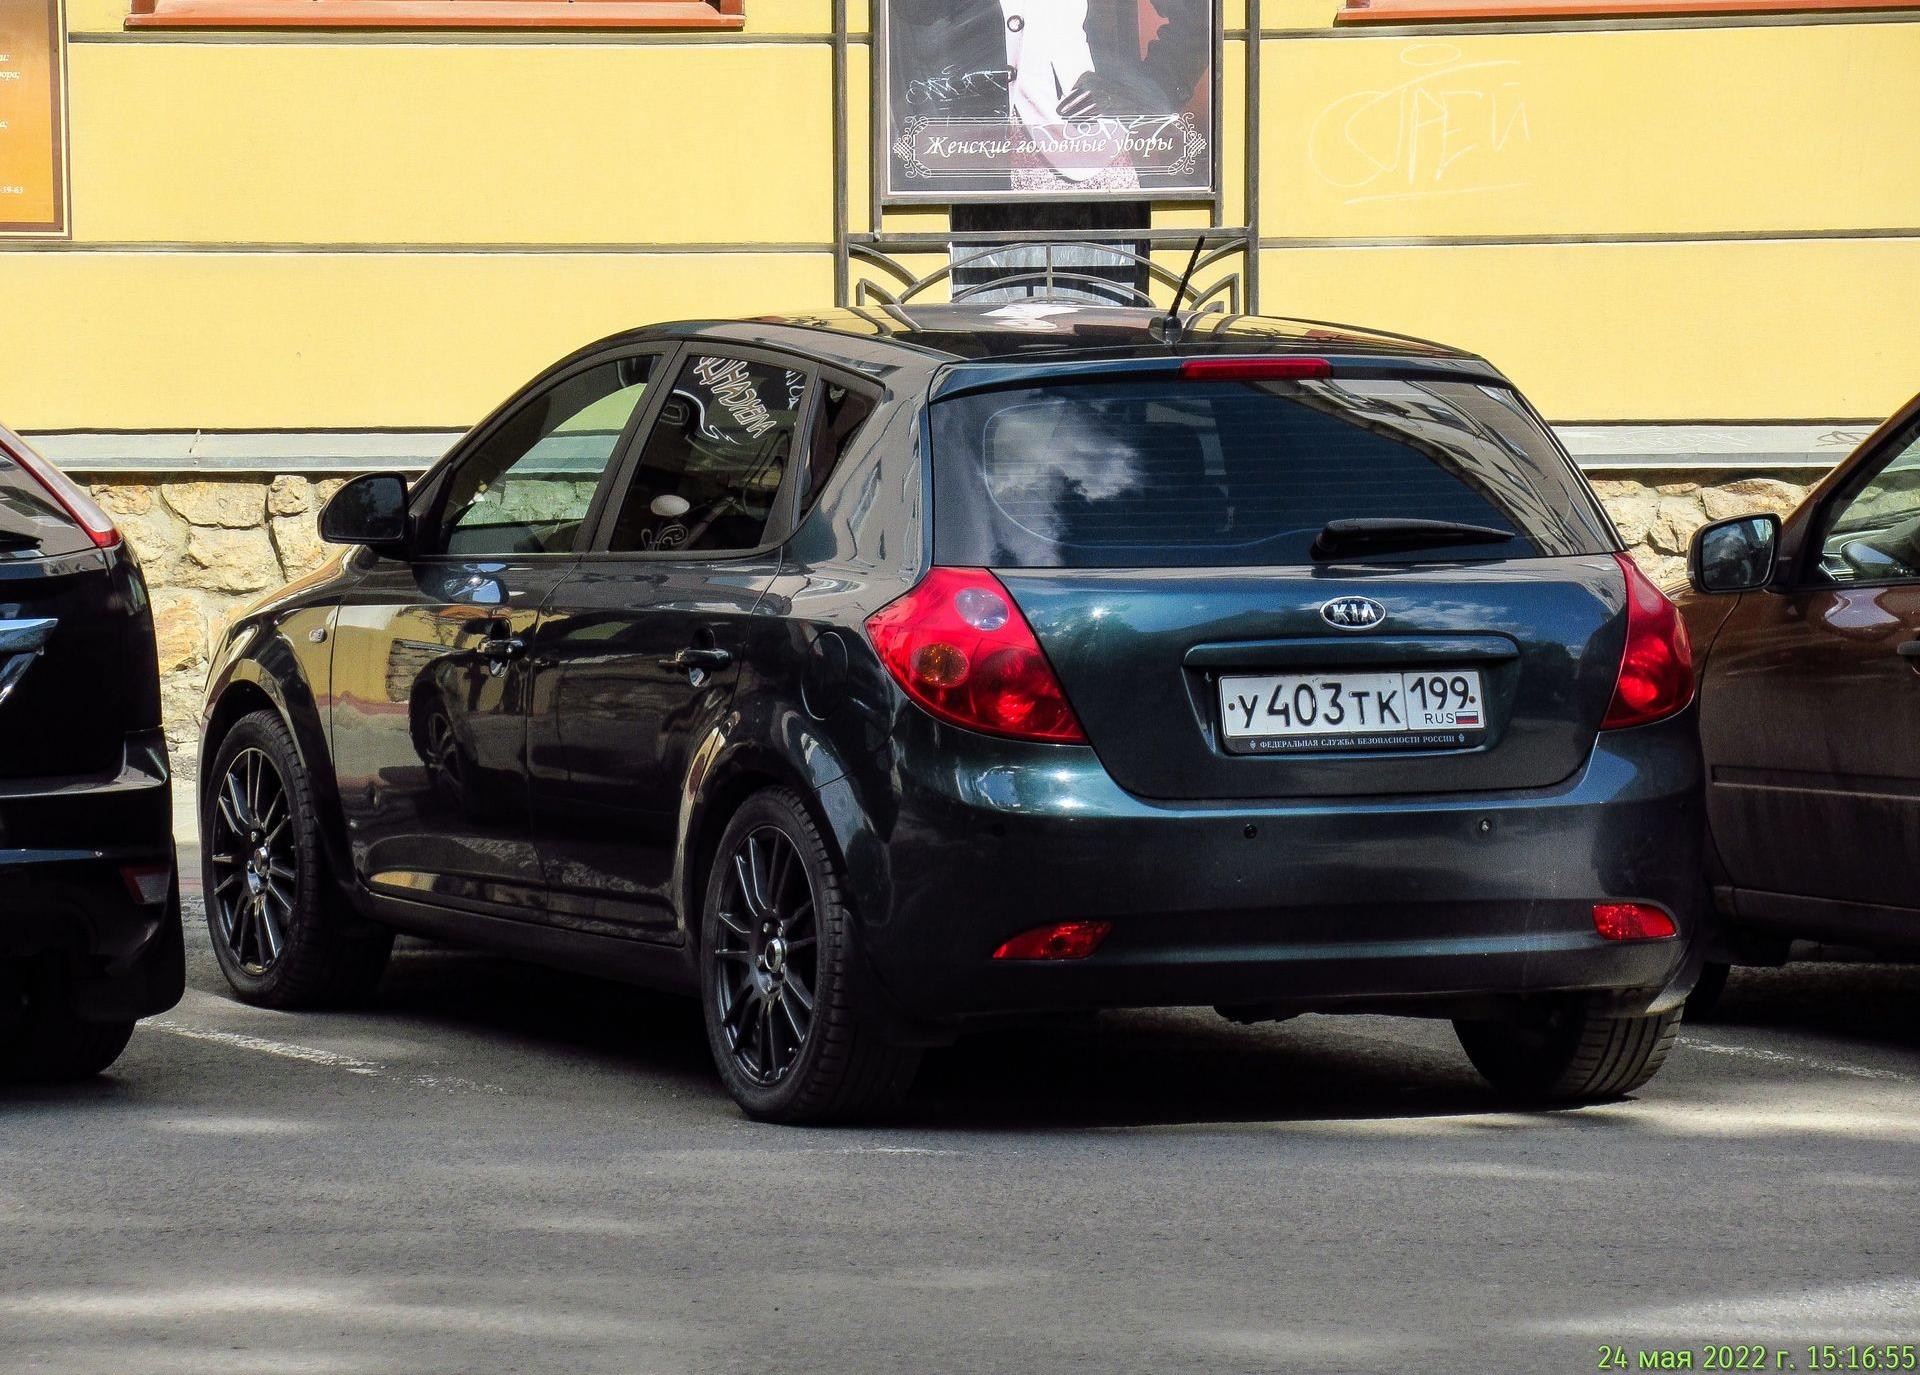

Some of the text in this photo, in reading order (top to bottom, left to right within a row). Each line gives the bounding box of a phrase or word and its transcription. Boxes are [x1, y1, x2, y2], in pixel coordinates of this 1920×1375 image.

[923, 132, 1174, 158] Женские головные уборы
[1331, 602, 1378, 623] KIA
[1409, 675, 1470, 711] 199
[1424, 713, 1455, 725] RUS
[1259, 734, 1456, 749] ФЕДЕРАЛЬНАЯ СЛУЖБА БЕЗОПАСНОСТИ РОССИИ
